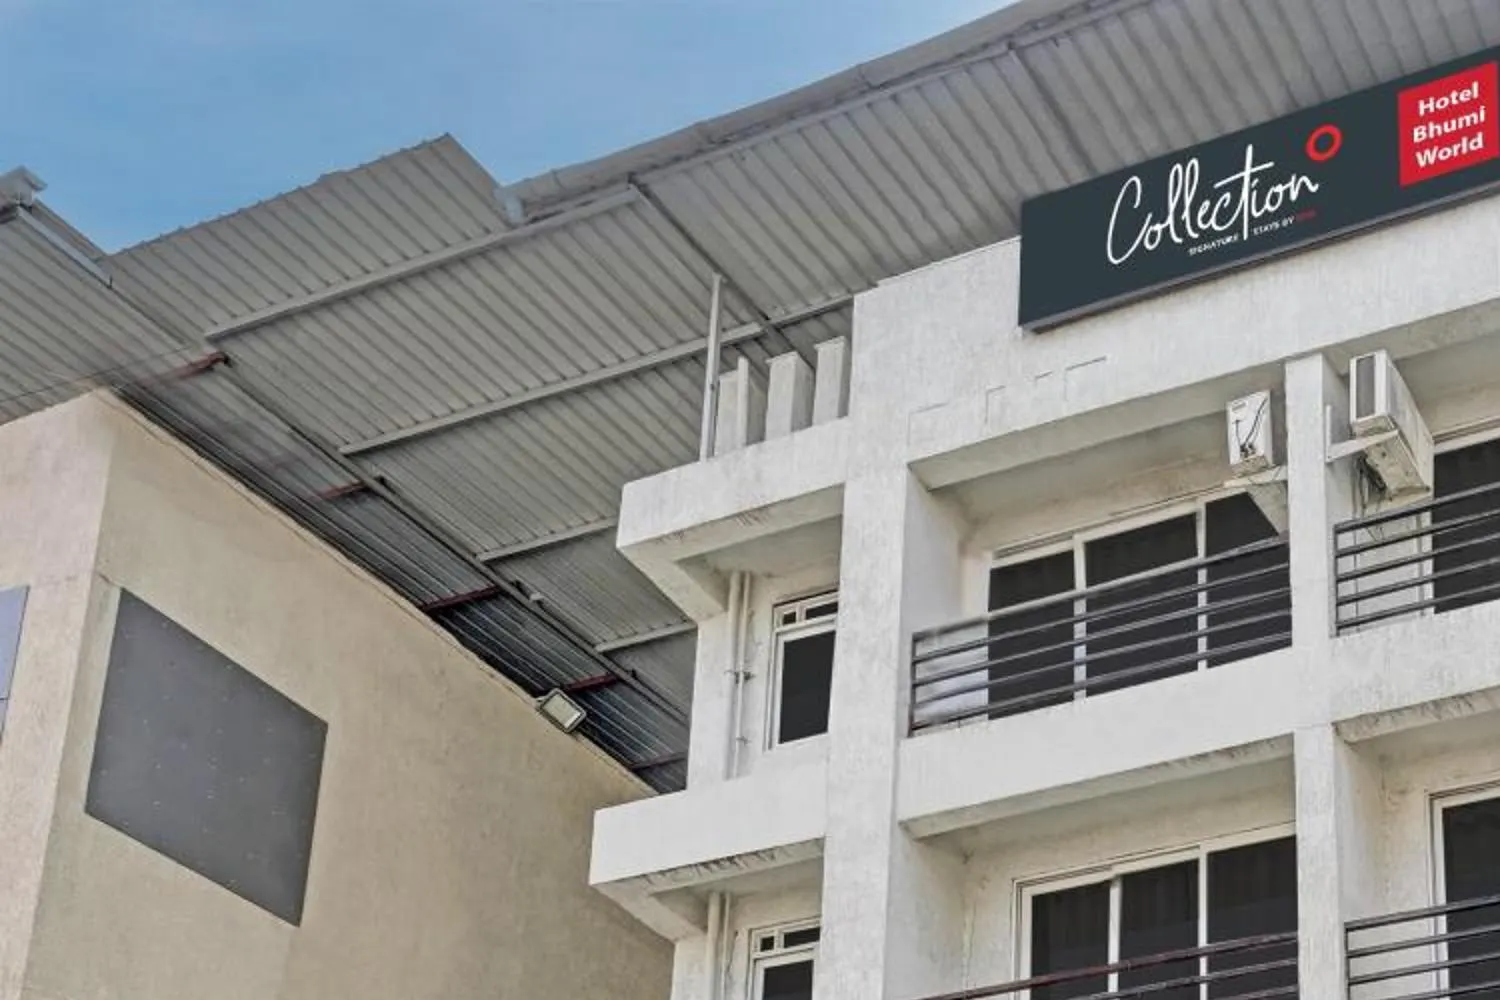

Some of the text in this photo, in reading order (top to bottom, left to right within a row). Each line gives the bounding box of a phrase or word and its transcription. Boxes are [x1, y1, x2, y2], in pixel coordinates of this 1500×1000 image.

[1418, 80, 1479, 117] Hotel
[1413, 105, 1486, 144] Bhumi
[1415, 131, 1484, 168] World
[1106, 143, 1319, 265] Collection
